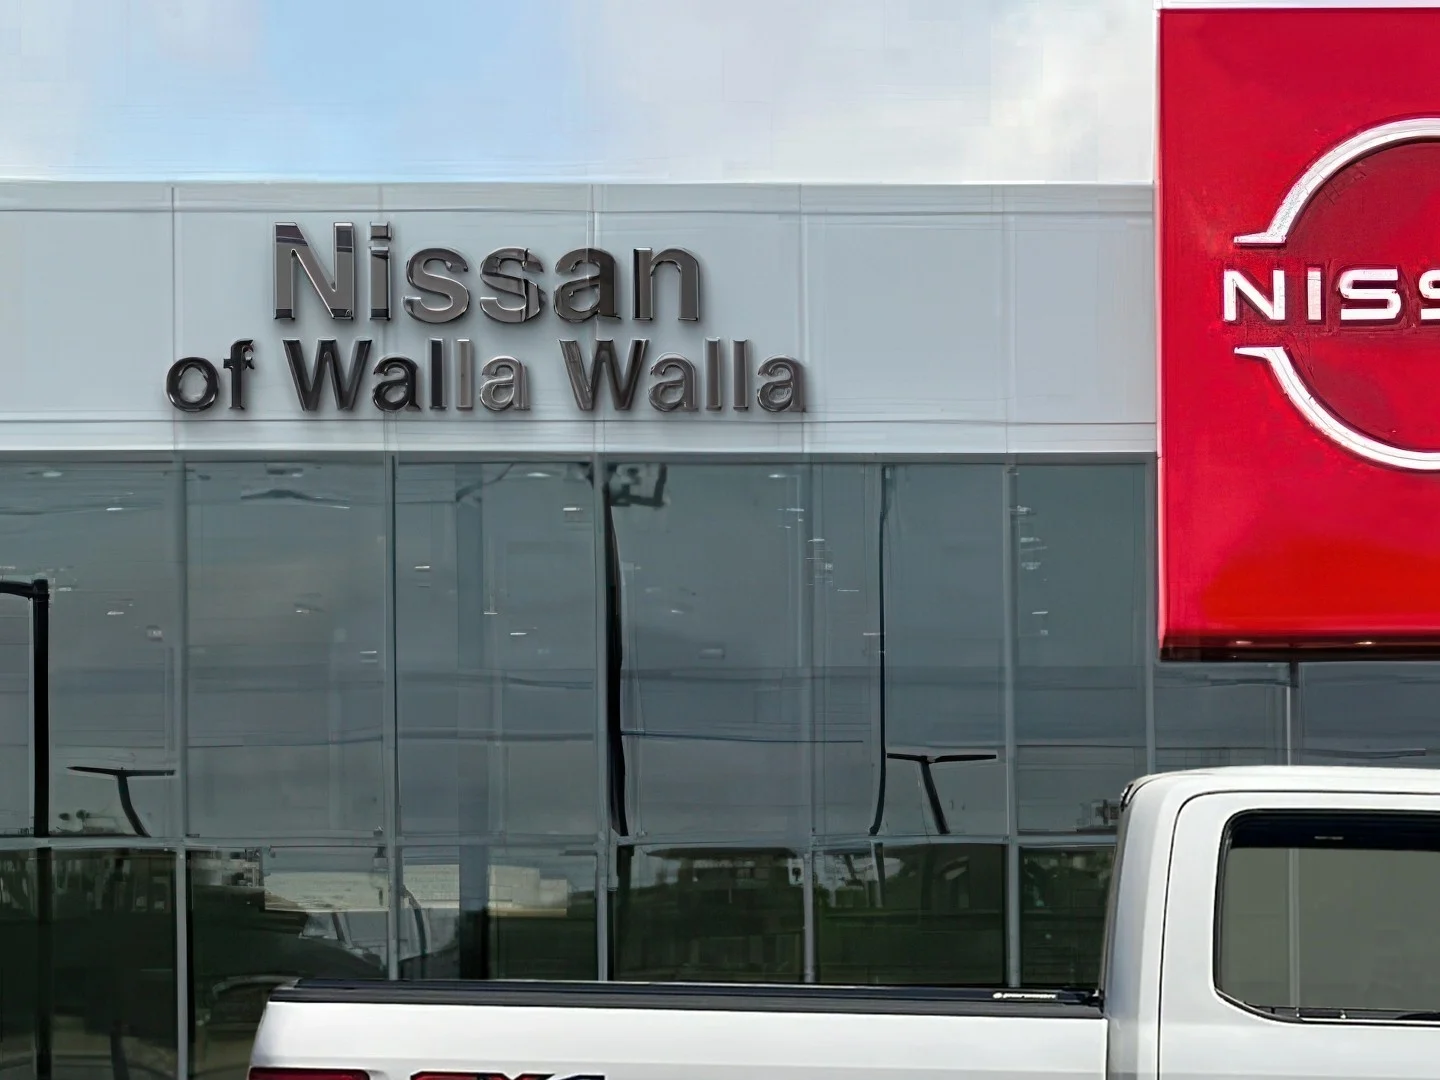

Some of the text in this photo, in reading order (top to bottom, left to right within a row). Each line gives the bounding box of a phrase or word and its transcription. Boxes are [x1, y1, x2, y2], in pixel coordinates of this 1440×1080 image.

[272, 221, 708, 325] Nissan
[165, 337, 808, 413] of Walla Walla
